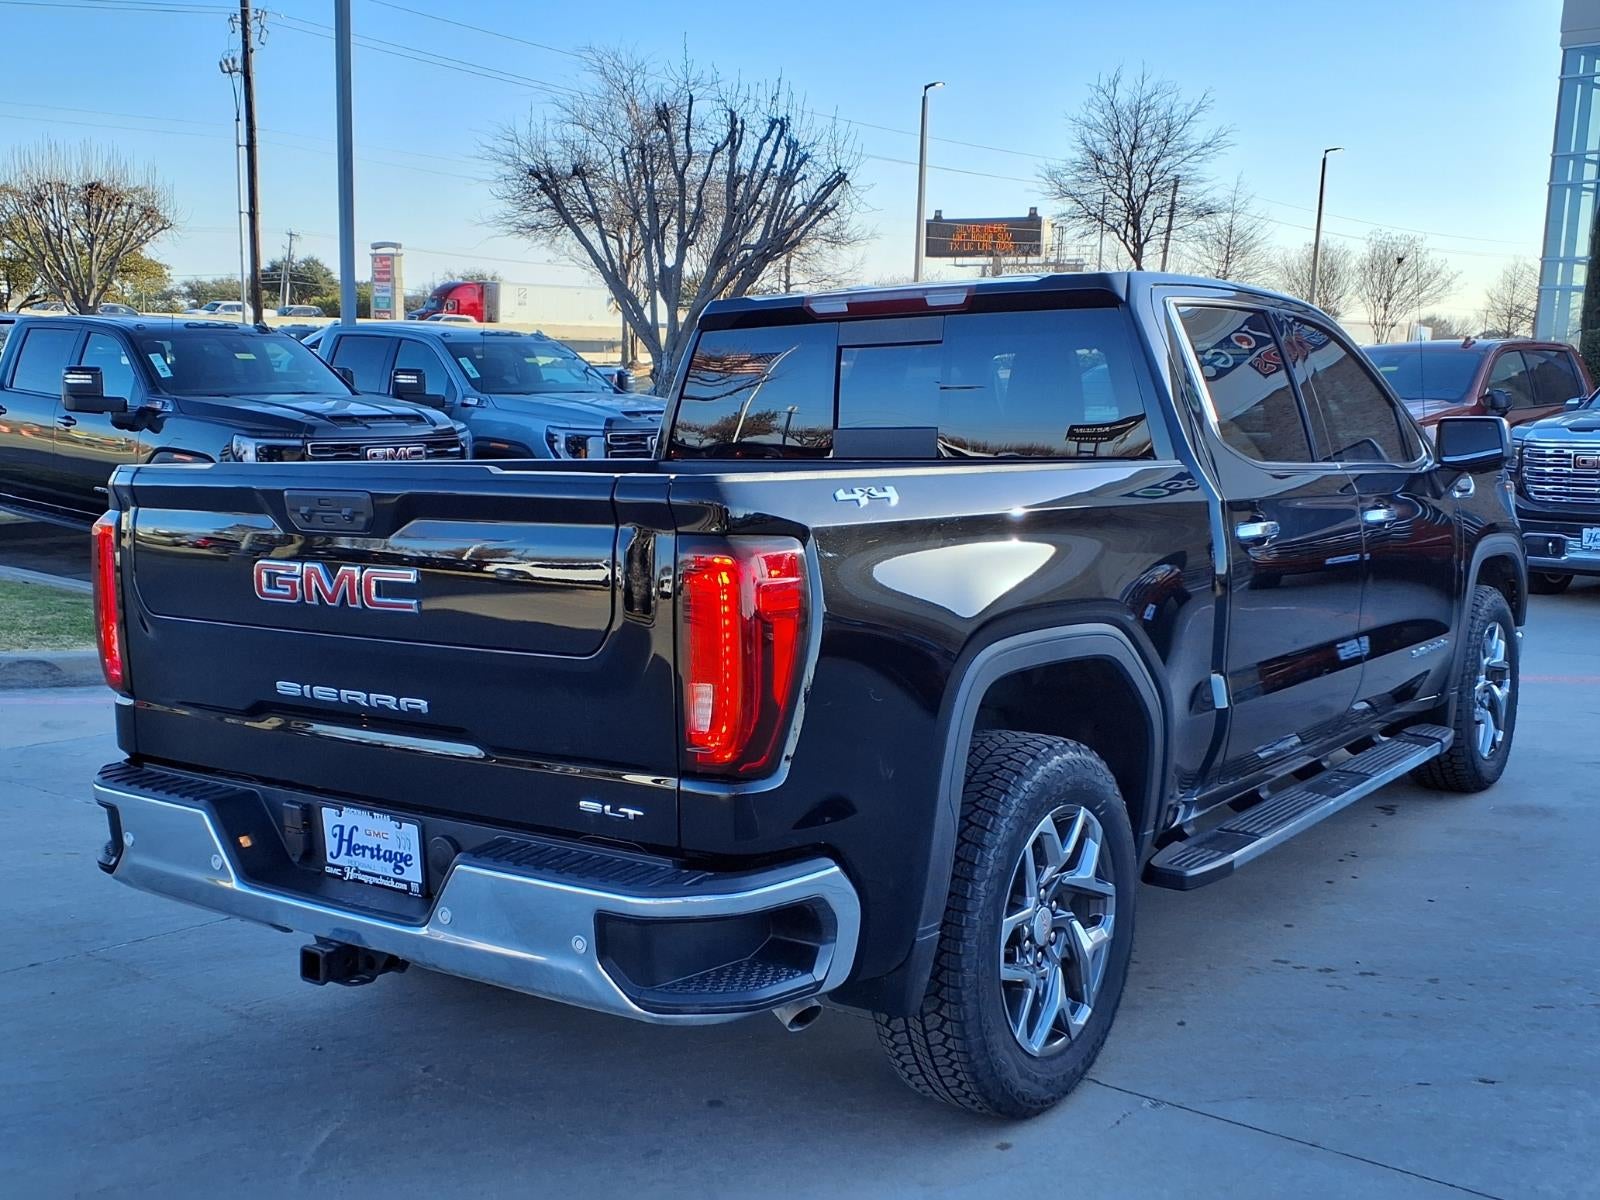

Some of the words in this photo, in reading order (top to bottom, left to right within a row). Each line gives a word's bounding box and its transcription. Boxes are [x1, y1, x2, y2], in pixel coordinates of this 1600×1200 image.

[956, 224, 980, 233] SILVER
[984, 223, 1008, 233] ALERT
[997, 232, 1012, 241] SUV
[950, 242, 959, 251] TX
[367, 446, 425, 461] GMC
[254, 559, 419, 613] GMC
[276, 681, 428, 714] SIERRA
[579, 800, 644, 820] SLT
[364, 829, 389, 840] GMC
[329, 824, 413, 875] Heritage
[325, 866, 342, 876] GMC
